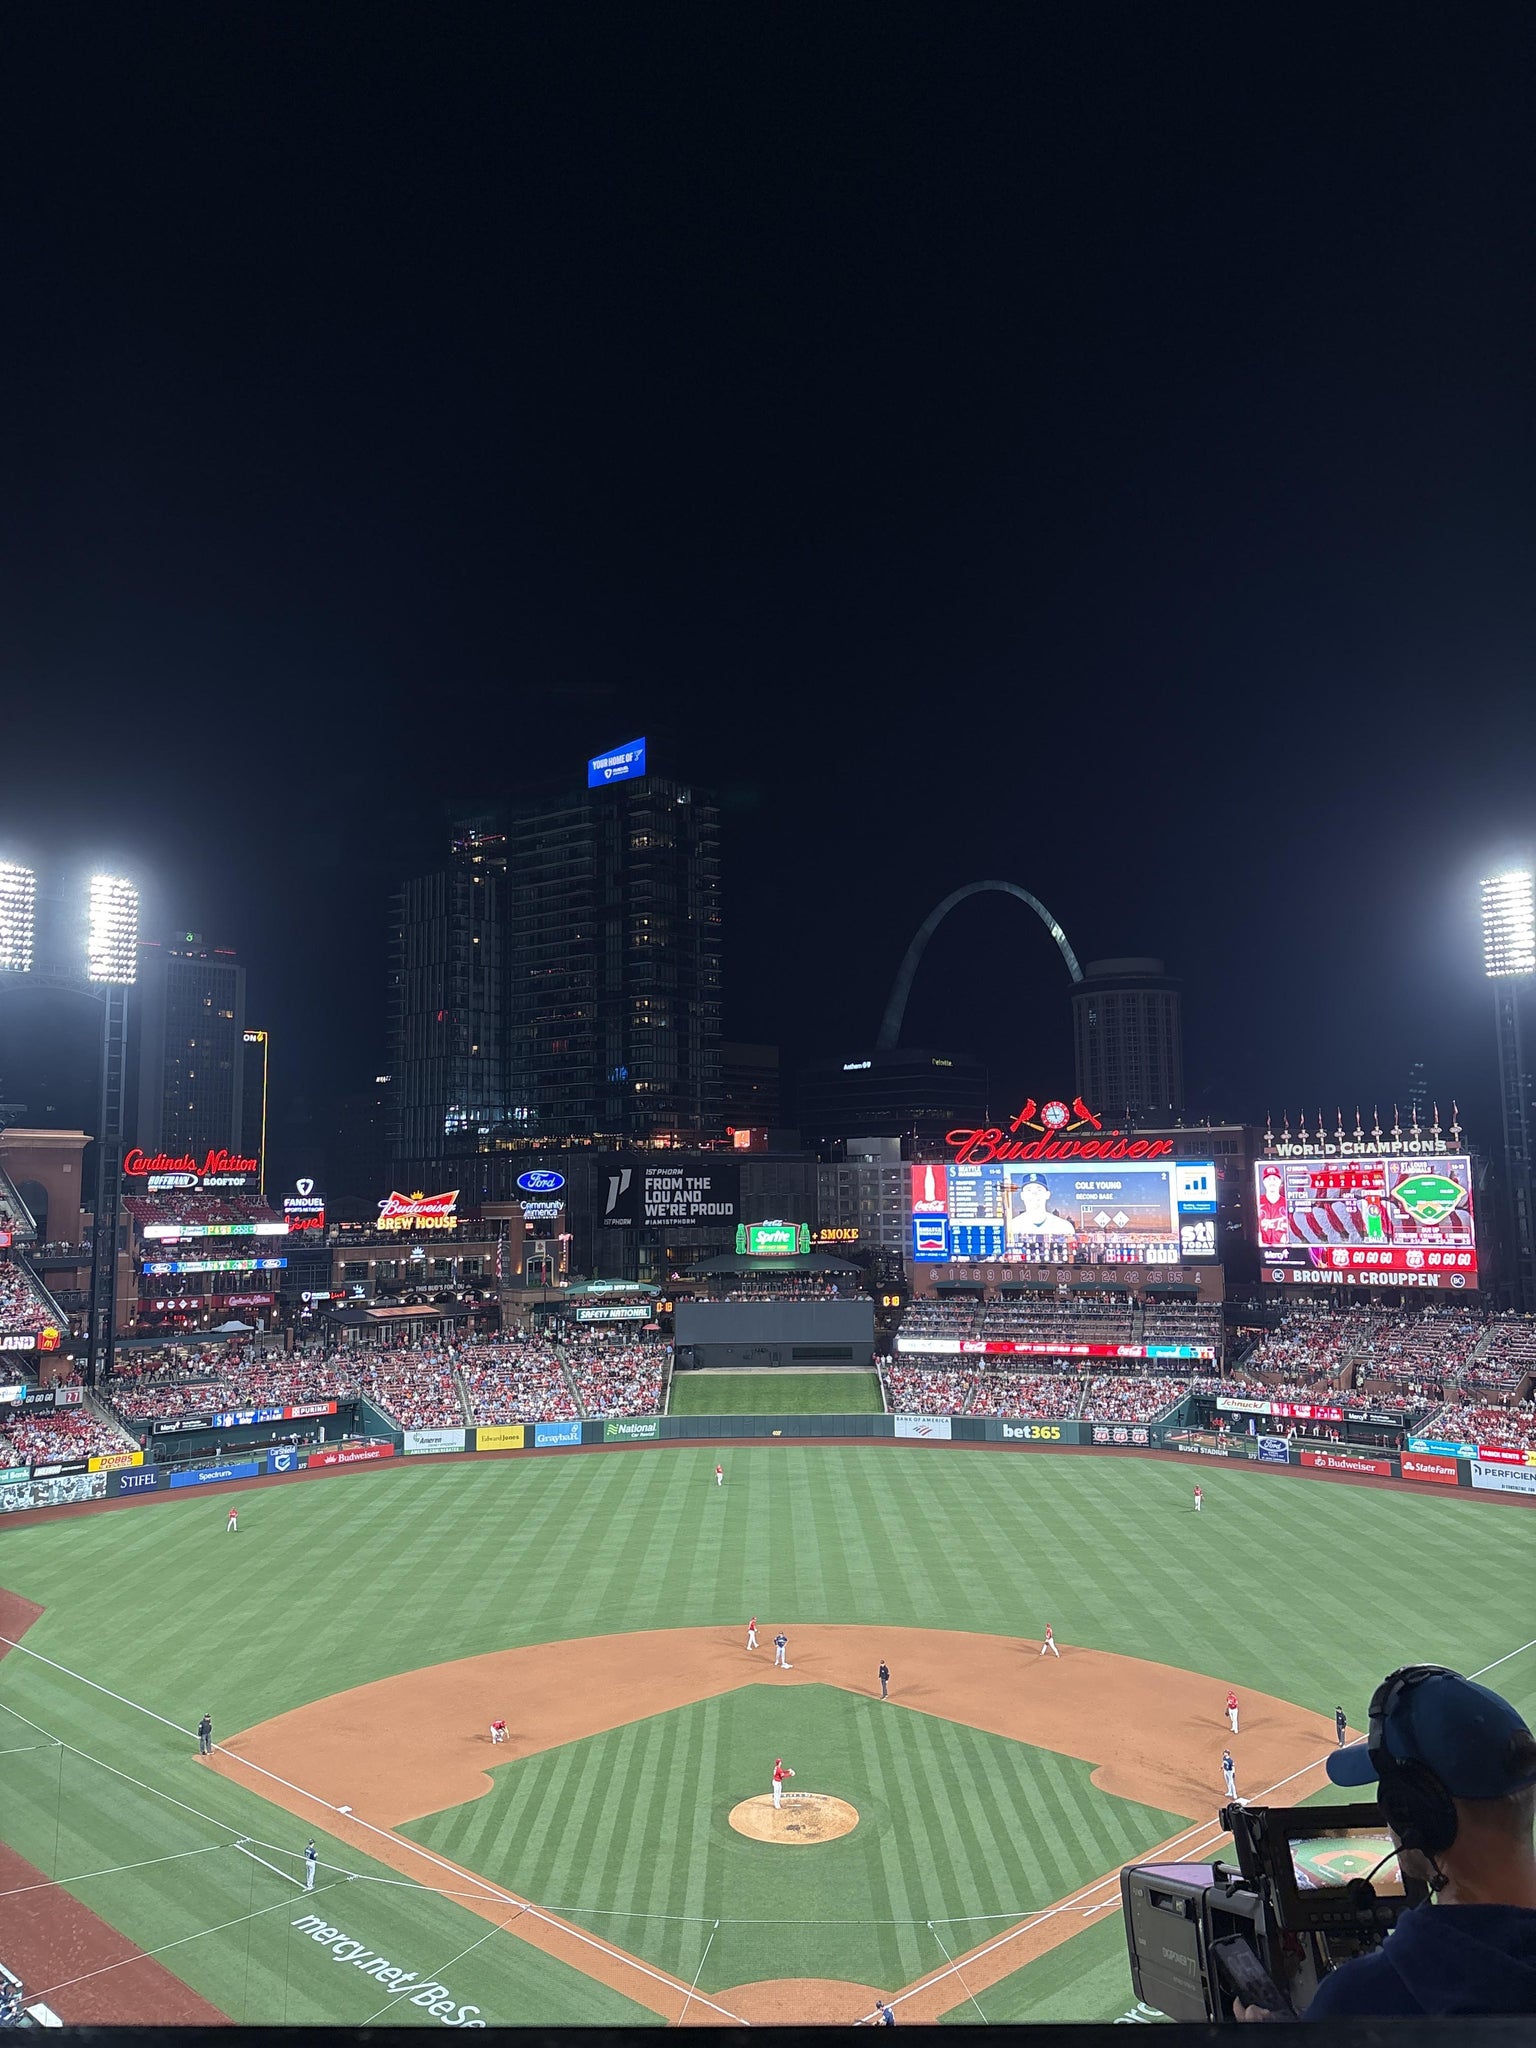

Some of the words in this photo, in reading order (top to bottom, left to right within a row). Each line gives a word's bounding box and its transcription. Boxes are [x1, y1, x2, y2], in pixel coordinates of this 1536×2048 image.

[593, 760, 608, 770] YOUR
[608, 757, 625, 767] HOME
[625, 752, 633, 762] OF
[945, 1129, 1174, 1165] Budweiser
[1276, 1143, 1337, 1157] WORLD
[1340, 1140, 1446, 1155] CHAMPIONS
[123, 1148, 197, 1175] Cardinals
[196, 1149, 258, 1175] Nation
[202, 1177, 246, 1186] ROOFTOP
[527, 1172, 556, 1188] Ford
[645, 1178, 683, 1190] FROM
[686, 1177, 711, 1190] THE
[1075, 1181, 1095, 1190] COLE
[1095, 1181, 1122, 1190] YOUNG
[645, 1191, 670, 1203] LOU
[673, 1190, 702, 1203] AND
[1287, 1191, 1308, 1199] PITCH
[284, 1198, 325, 1207] FANDUEL
[377, 1199, 457, 1217] Budweiser
[520, 1200, 564, 1210] Community
[644, 1204, 687, 1216] WE'RE
[690, 1203, 734, 1215] PROUD
[376, 1216, 414, 1230] BREW
[415, 1215, 458, 1229] HOUSE
[756, 1230, 791, 1245] Sprite
[820, 1228, 859, 1240] SMOKE
[1180, 1221, 1215, 1242] stl
[1182, 1241, 1215, 1250] TODAY
[1353, 1252, 1364, 1263] GO
[1366, 1252, 1378, 1264] GO
[1380, 1252, 1392, 1264] GO
[1428, 1253, 1441, 1265] GO
[1442, 1253, 1455, 1265] GO
[1457, 1253, 1471, 1266] GO
[959, 1269, 968, 1280] 2
[972, 1269, 981, 1280] 6
[986, 1269, 995, 1280] 9
[1001, 1269, 1013, 1281] 10
[1019, 1269, 1031, 1282] 14
[1037, 1270, 1050, 1282] 17
[1056, 1270, 1072, 1283] 20
[1080, 1270, 1095, 1283] 23
[1101, 1270, 1117, 1283] 24
[1123, 1271, 1139, 1283] 42
[1147, 1271, 1163, 1283] 45
[1167, 1271, 1183, 1283] 85
[1274, 1271, 1283, 1279] BC
[1293, 1269, 1343, 1283] BROWN
[1347, 1274, 1356, 1283] &
[1359, 1271, 1439, 1287] CROUPPEN
[1452, 1277, 1464, 1285] BC
[443, 1283, 454, 1291] FOR
[580, 1310, 609, 1319] SAFETY
[609, 1308, 648, 1318] NATIONAL
[25, 1395, 35, 1403] GO
[35, 1394, 44, 1402] GO
[45, 1393, 54, 1401] GO
[67, 1392, 79, 1402] 27
[300, 1405, 328, 1414] PURINA
[1221, 1398, 1265, 1409] Schnucks
[1348, 1412, 1363, 1421] Mercy
[160, 1423, 176, 1432] Mercy
[618, 1422, 656, 1434] National
[1003, 1424, 1061, 1440] bet365
[481, 1434, 502, 1442] Edward
[1263, 1438, 1282, 1449] Ford
[270, 1445, 296, 1456] CarShield
[338, 1449, 379, 1463] Budweiser
[1178, 1444, 1199, 1453] BUSCH
[1200, 1446, 1229, 1457] STADIUM
[1501, 1452, 1520, 1460] RENTS
[100, 1454, 133, 1466] DOBBS
[1328, 1457, 1376, 1472] Budweiser
[10, 1470, 30, 1480] Bank
[1415, 1462, 1435, 1473] State
[1435, 1465, 1456, 1476] Farm
[120, 1473, 157, 1489] STIFEL
[198, 1470, 227, 1481] Spectrum
